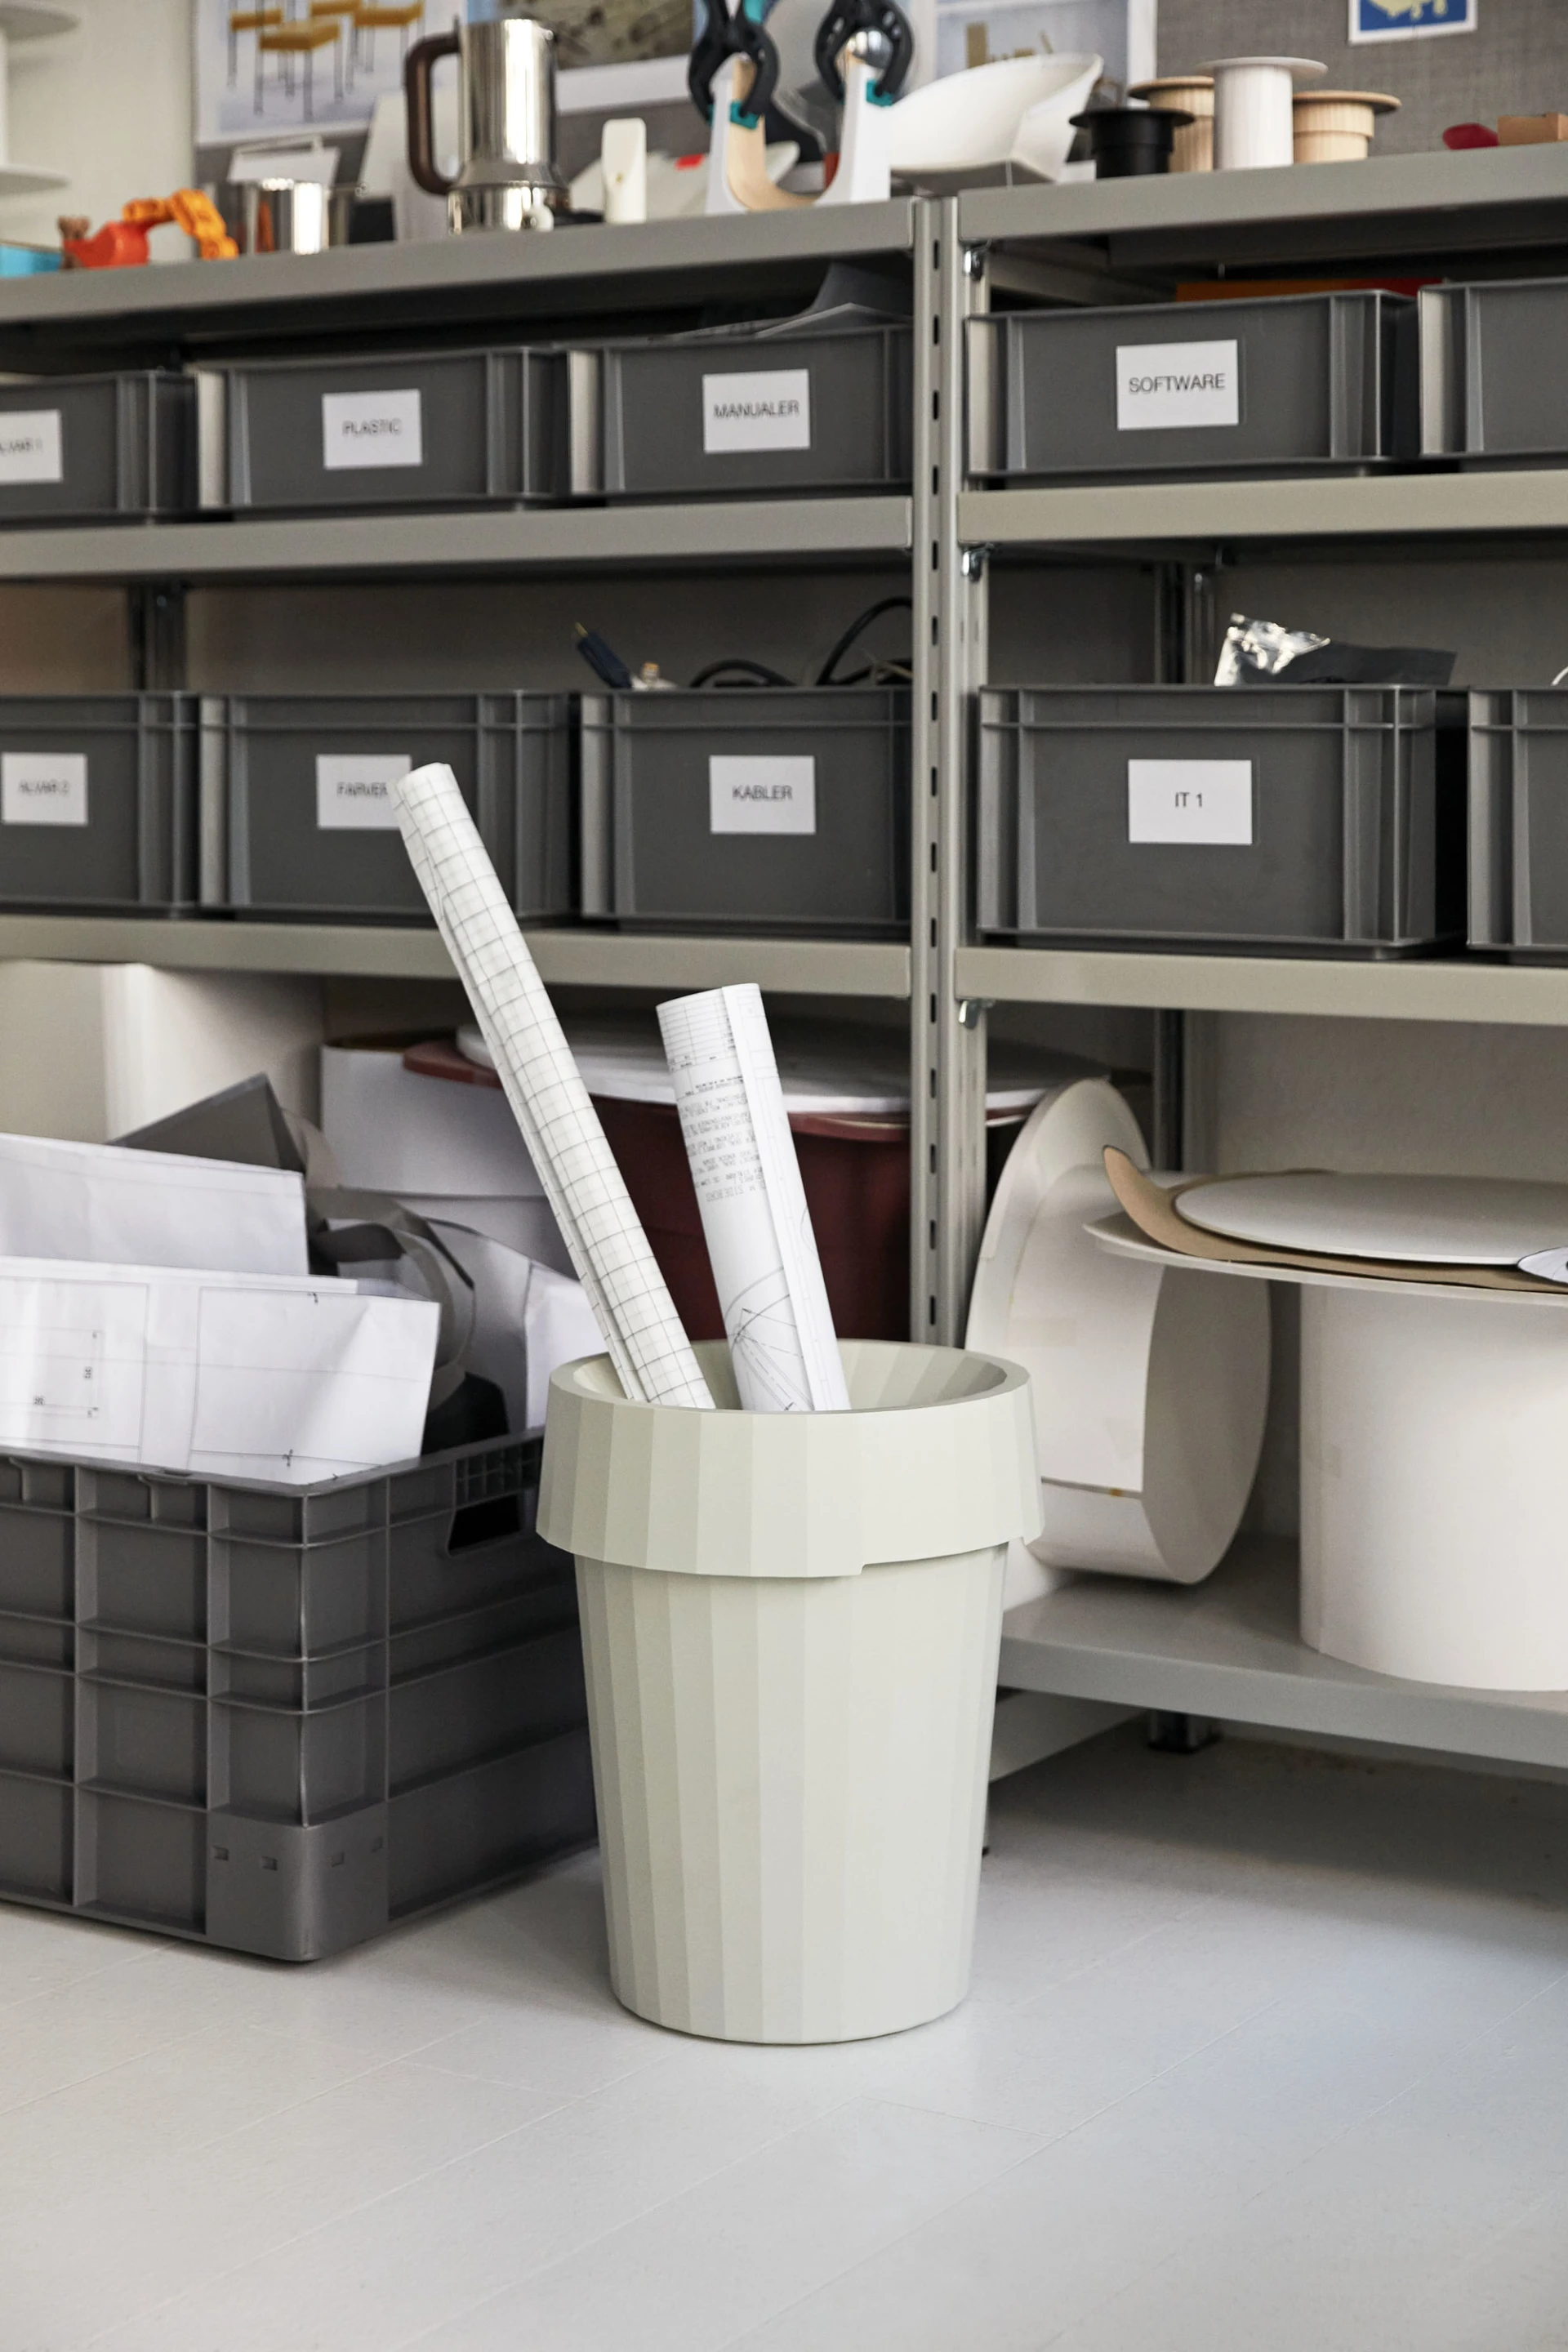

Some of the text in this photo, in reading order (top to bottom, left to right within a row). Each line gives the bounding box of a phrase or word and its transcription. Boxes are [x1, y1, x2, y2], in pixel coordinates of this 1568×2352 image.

[1129, 373, 1226, 394] SOFTWARE
[713, 399, 800, 419] MANUALER
[341, 417, 403, 437] PLASTIC
[732, 784, 793, 801] KABLER
[1175, 791, 1203, 808] IT 1
